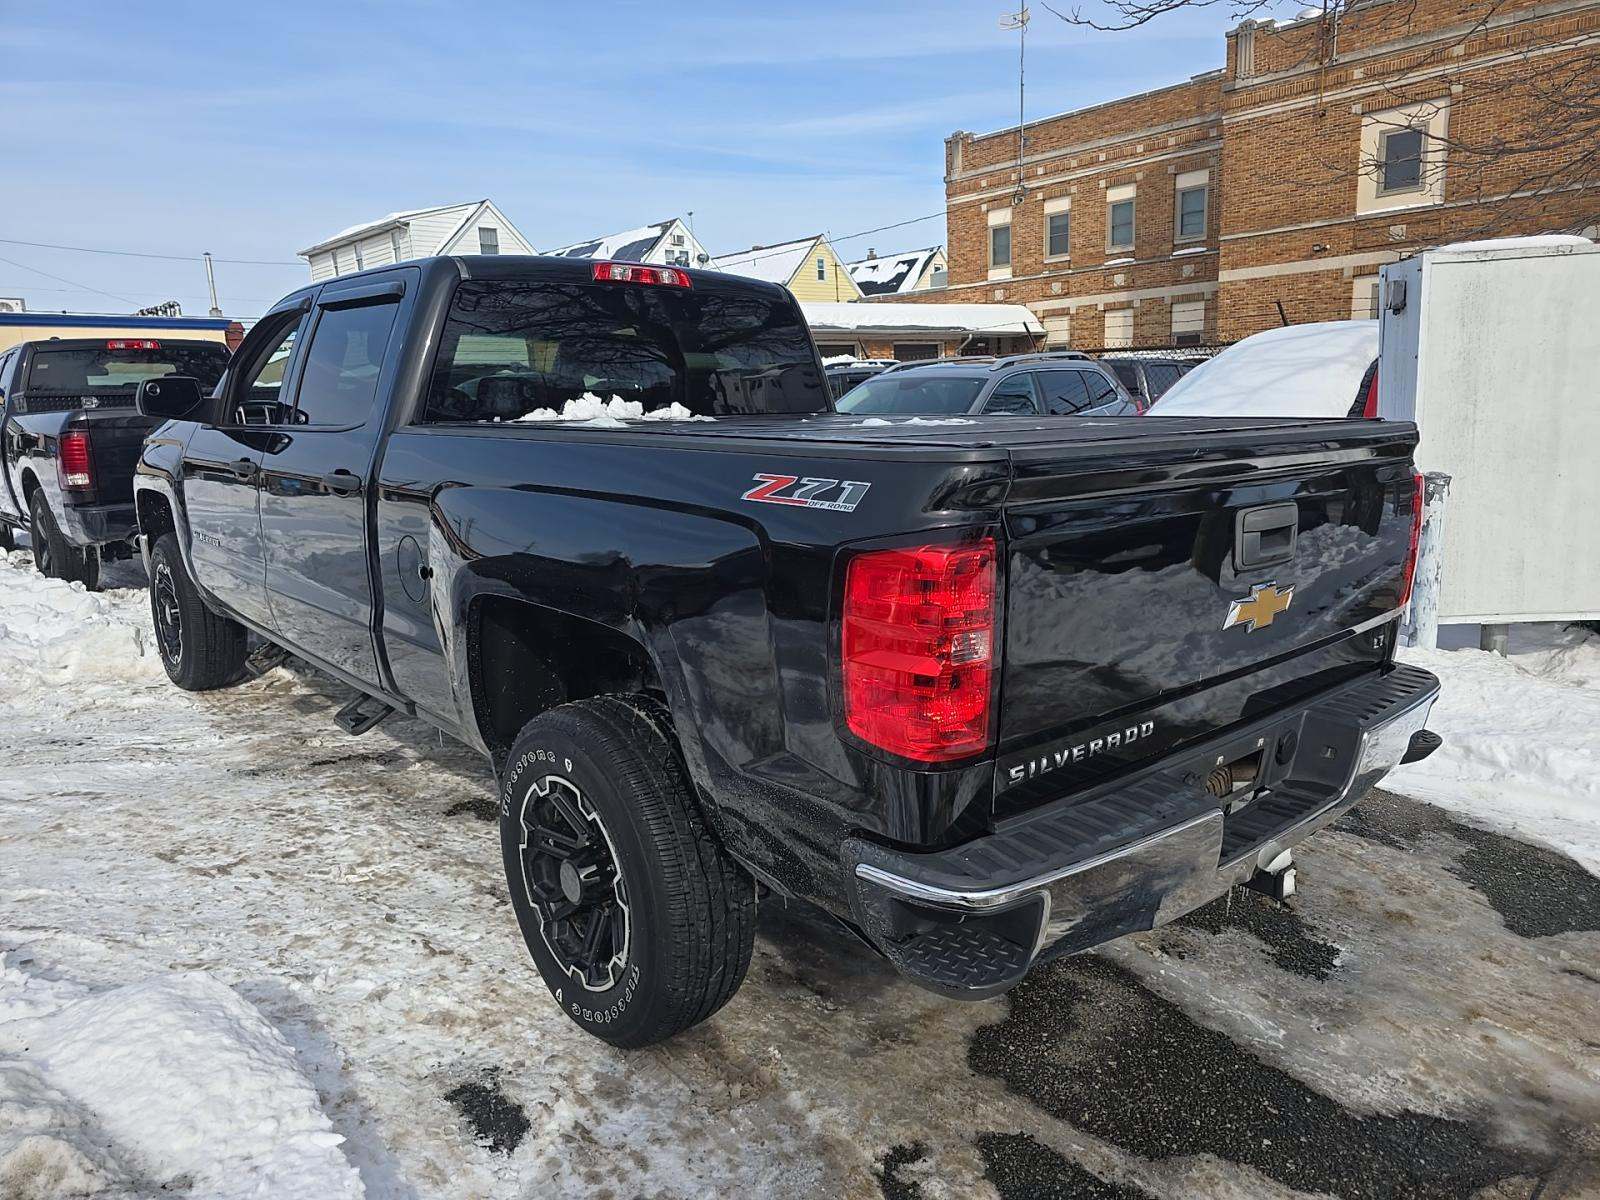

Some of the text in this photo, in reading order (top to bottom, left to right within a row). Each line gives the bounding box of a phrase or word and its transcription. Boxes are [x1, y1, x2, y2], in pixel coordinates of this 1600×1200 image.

[741, 472, 872, 506] Z71
[808, 500, 854, 511] OFF ROAD
[1008, 719, 1154, 786] SILVERADO
